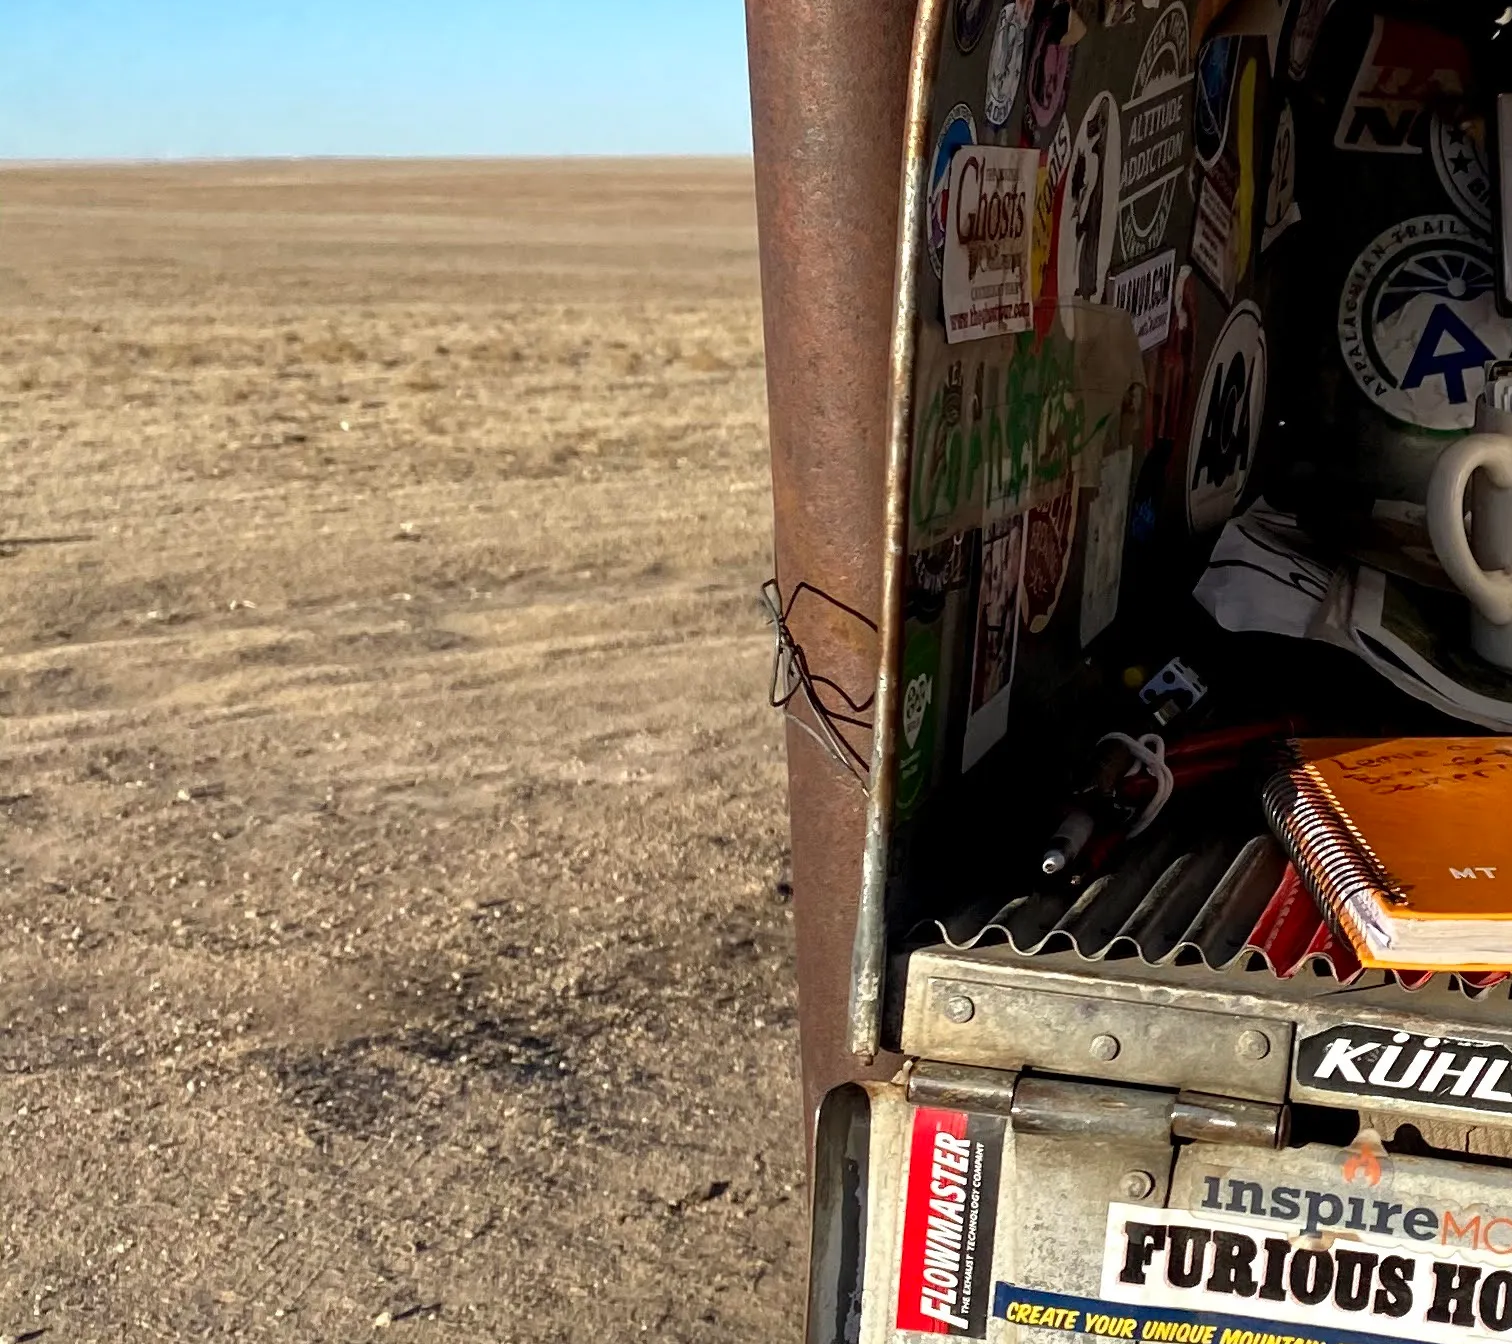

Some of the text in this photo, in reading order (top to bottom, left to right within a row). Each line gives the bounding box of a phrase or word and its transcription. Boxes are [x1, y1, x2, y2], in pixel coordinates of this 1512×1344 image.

[1127, 95, 1184, 146] ALTITUDE
[1120, 131, 1185, 188] ADDICTION
[956, 155, 1027, 245] Ghosts
[1391, 219, 1459, 243] TRAIL
[1449, 867, 1497, 880] MT
[972, 1141, 985, 1189] COMPANY
[920, 1130, 971, 1331] FLOWMASTER
[966, 1189, 980, 1253] TECHNOLOGY
[1119, 1221, 1415, 1320] FURIOUS
[961, 1295, 971, 1314] THE
[1005, 1301, 1077, 1328] CREATE
[1084, 1313, 1136, 1339] YOUR
